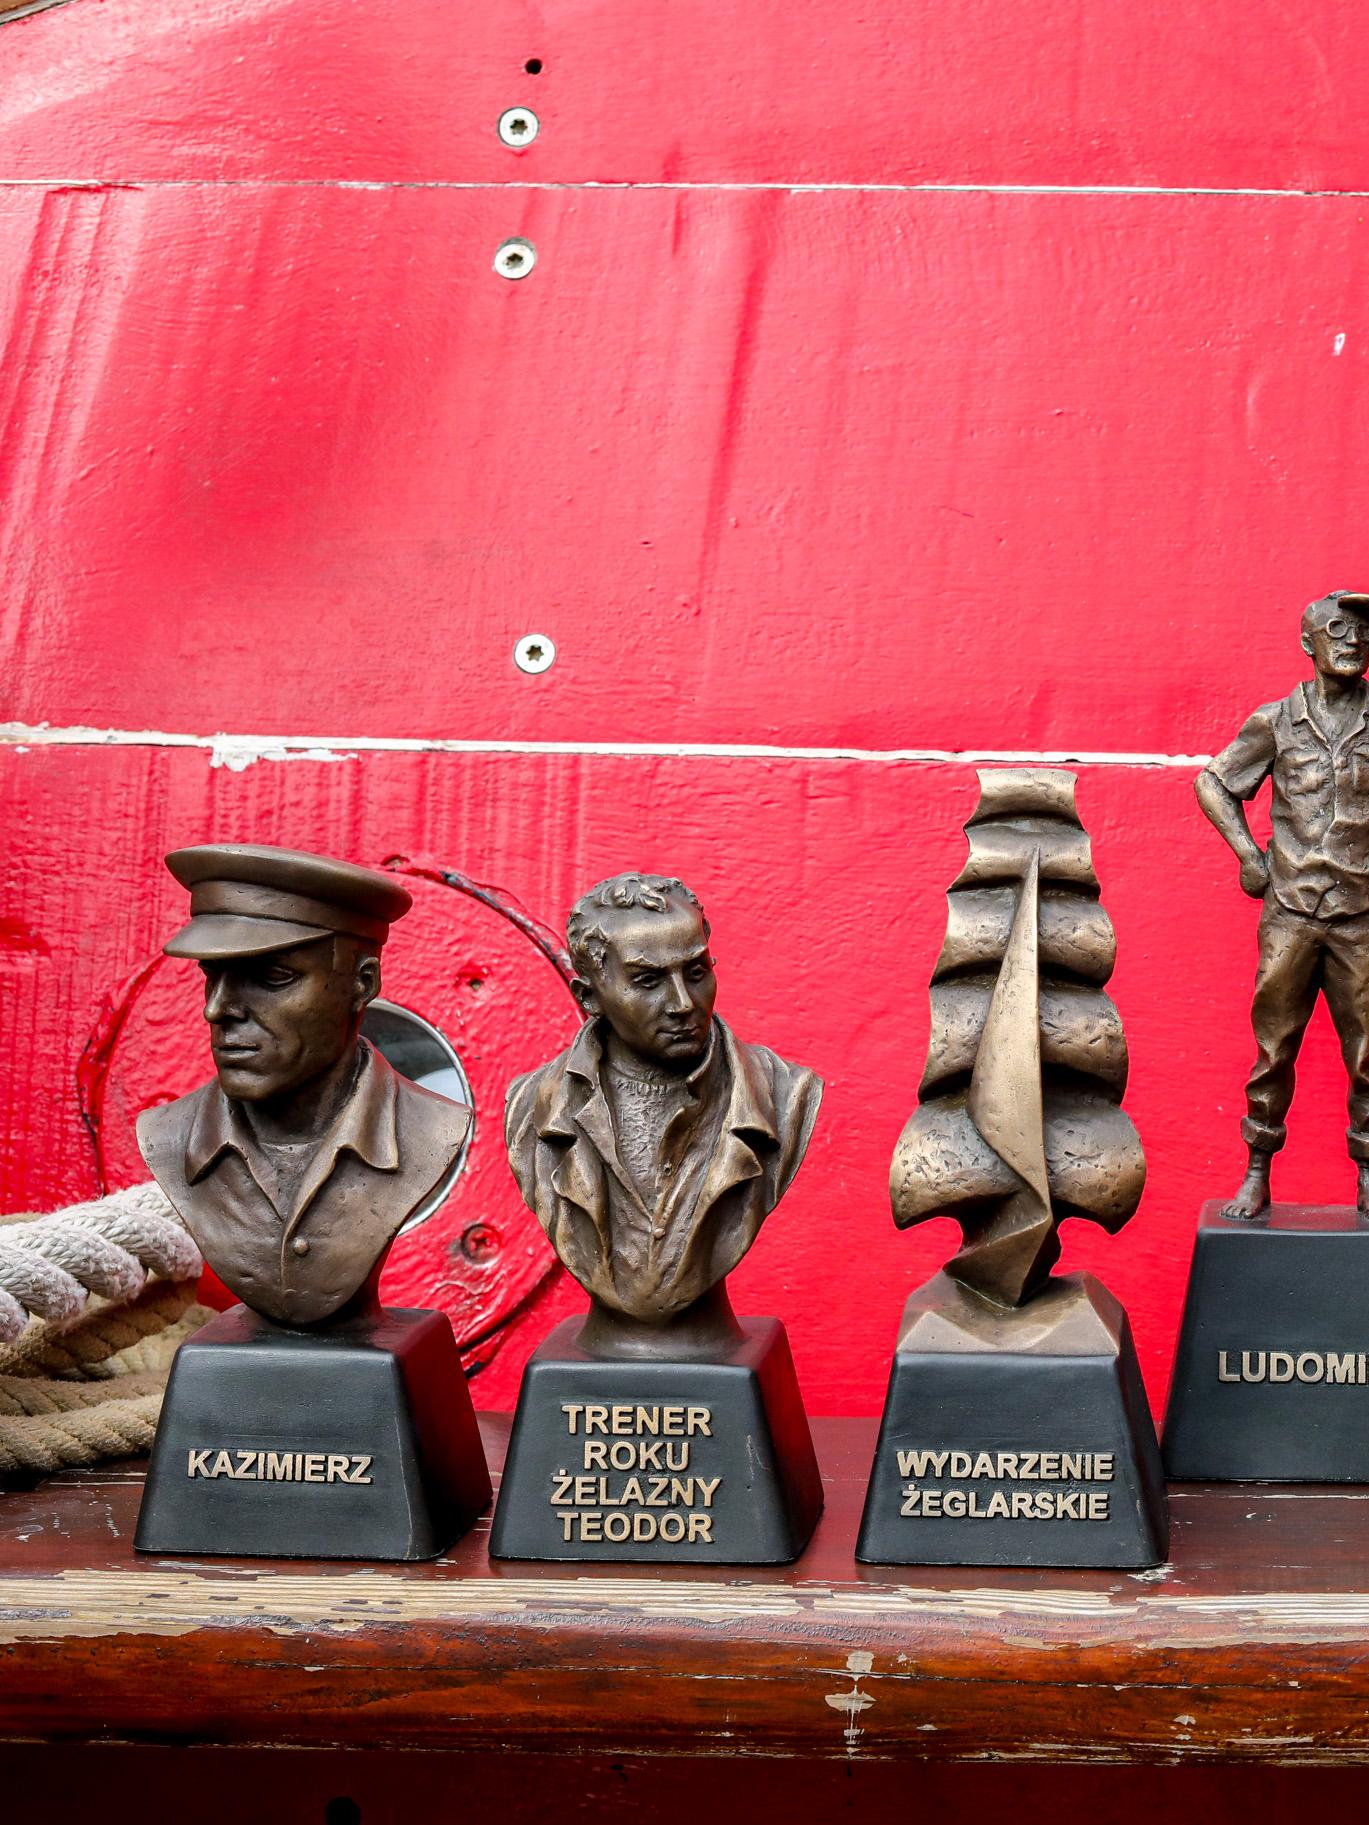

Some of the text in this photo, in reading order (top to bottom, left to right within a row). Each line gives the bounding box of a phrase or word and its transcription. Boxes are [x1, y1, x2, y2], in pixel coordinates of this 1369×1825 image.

[561, 1404, 711, 1437] TRENER
[187, 1448, 373, 1485] KAZIMIERZ
[583, 1440, 691, 1471] ROKU
[896, 1449, 1114, 1481] WYDARZENIE
[551, 1470, 721, 1507] ŻELAZNY
[900, 1483, 1112, 1520] ŻEGLARSKIE
[557, 1511, 713, 1543] TEODOR
